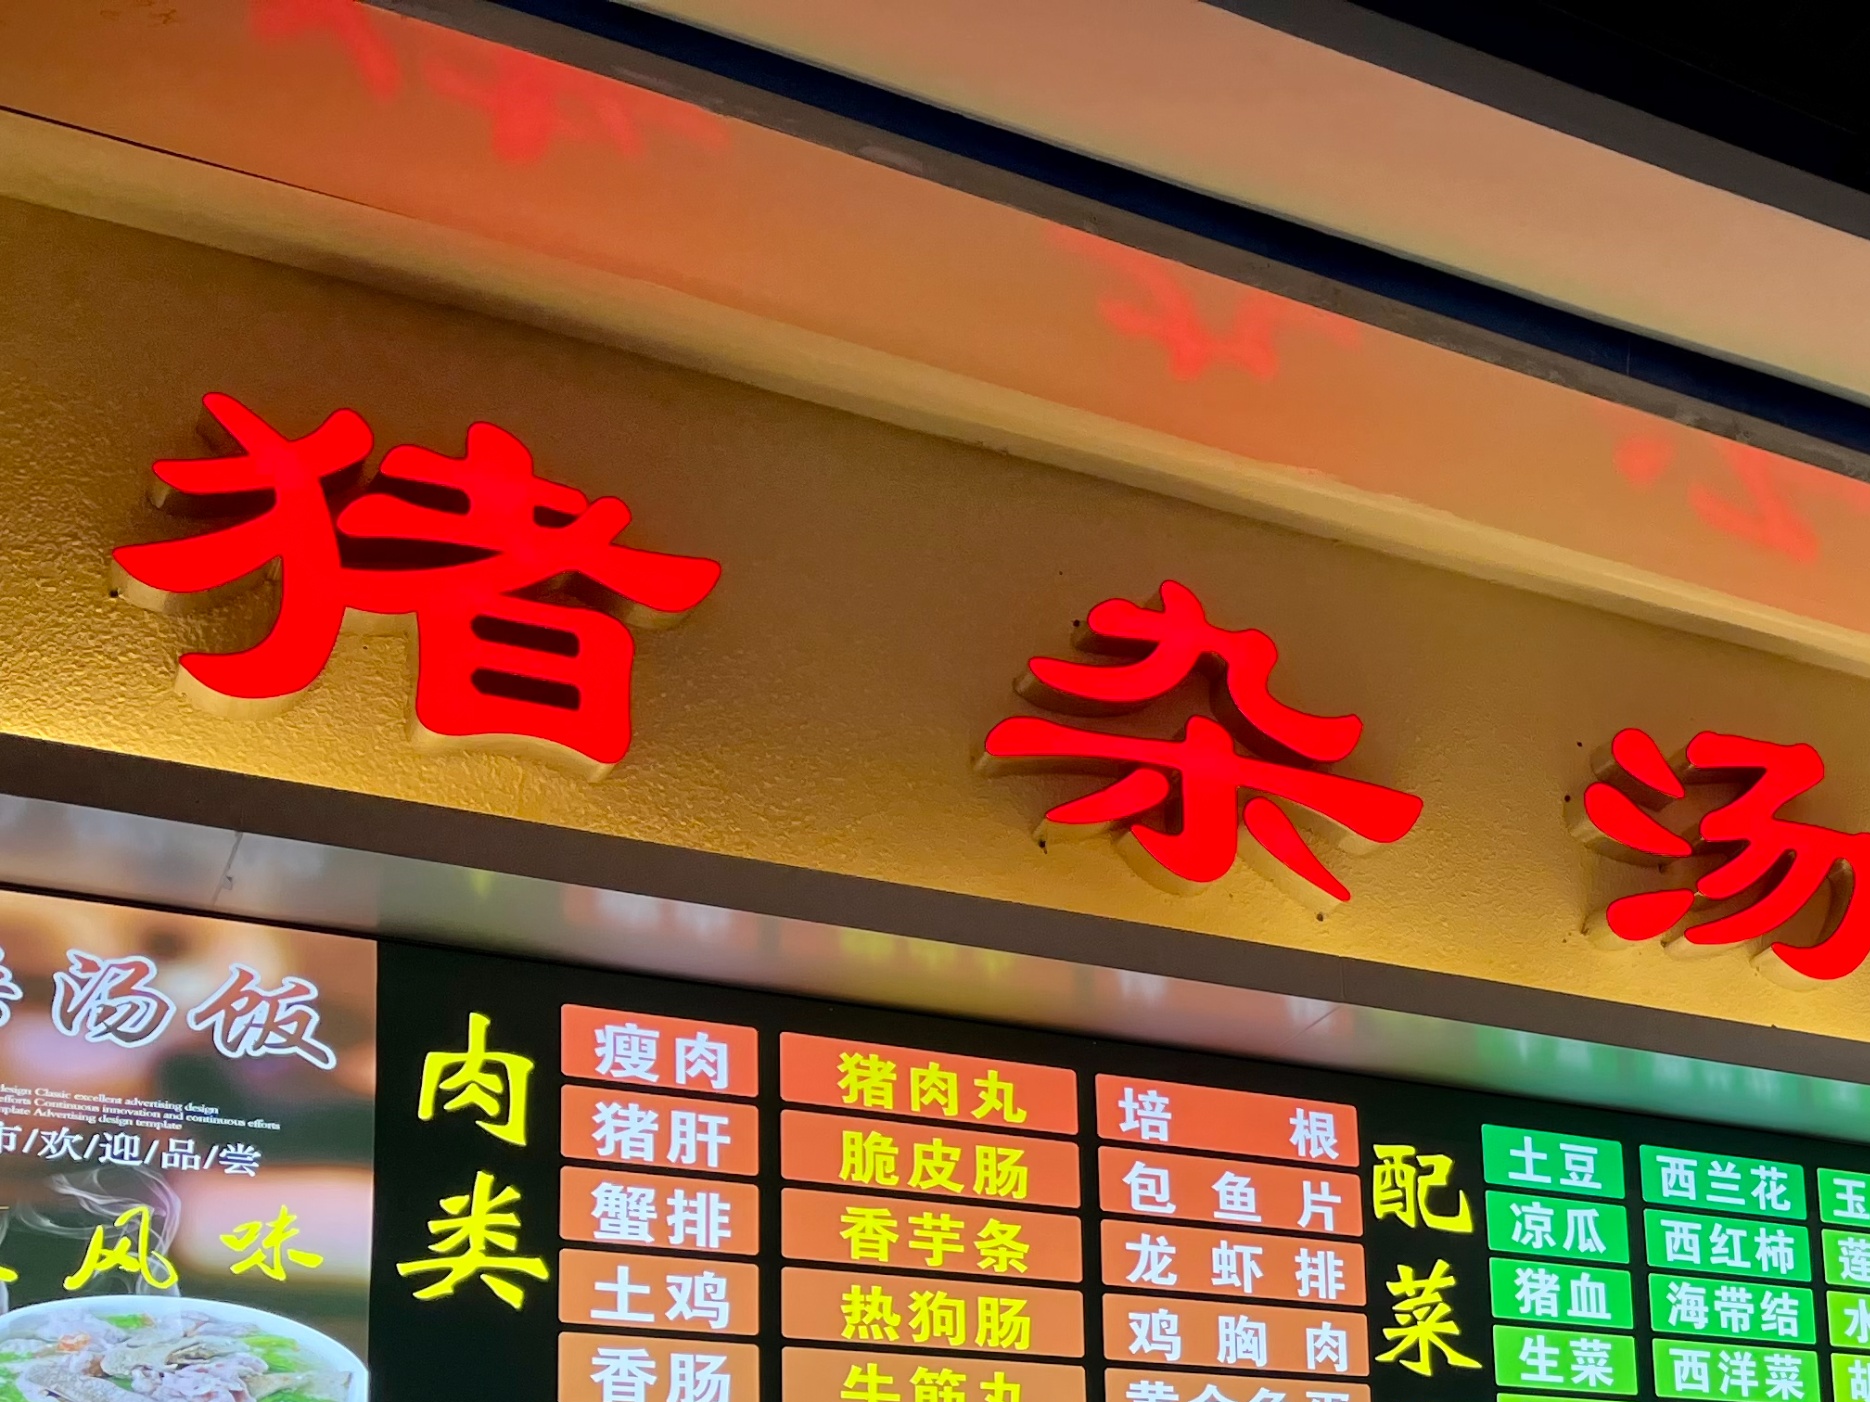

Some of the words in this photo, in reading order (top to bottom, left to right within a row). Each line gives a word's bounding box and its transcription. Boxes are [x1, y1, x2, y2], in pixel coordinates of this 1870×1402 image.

[0, 948, 337, 1070] 汤饭
[594, 1022, 730, 1090] 瘦肉
[837, 1052, 1027, 1126] 猪肉丸
[33, 1108, 97, 1124] Advertising
[98, 1114, 133, 1128] design
[135, 1118, 182, 1131] template
[34, 1087, 72, 1099] Classic
[74, 1093, 122, 1105] excellent
[124, 1096, 183, 1112] advertising
[184, 1102, 219, 1115] design
[34, 1097, 100, 1112] Continuous
[102, 1104, 161, 1120] innovation
[163, 1111, 184, 1121] and
[186, 1115, 245, 1128] continuous
[247, 1119, 280, 1131] efforts
[1118, 1087, 1341, 1160] 培根
[397, 1011, 550, 1311] 肉类
[592, 1101, 732, 1168] 猪肝
[838, 1130, 1029, 1201] 脆皮肠
[1508, 1135, 1603, 1191] 土豆
[591, 1180, 732, 1249] 蟹排
[1122, 1161, 1342, 1232] 包鱼片
[1655, 1154, 1792, 1212] 西兰花
[0, 1204, 324, 1290] 风味
[840, 1206, 1030, 1274] 香芋条
[1371, 1143, 1483, 1377] 配菜
[1509, 1201, 1607, 1255] 凉瓜
[1660, 1218, 1795, 1275] 西红柿
[590, 1264, 731, 1330] 土鸡
[1125, 1233, 1346, 1299] 龙虾排
[1513, 1266, 1612, 1321] 猪血
[840, 1285, 1031, 1352] 热狗肠
[1127, 1308, 1348, 1372] 鸡胸肉
[1666, 1281, 1800, 1338] 海带结
[1518, 1334, 1615, 1388] 生菜
[1668, 1346, 1805, 1402] 西洋菜
